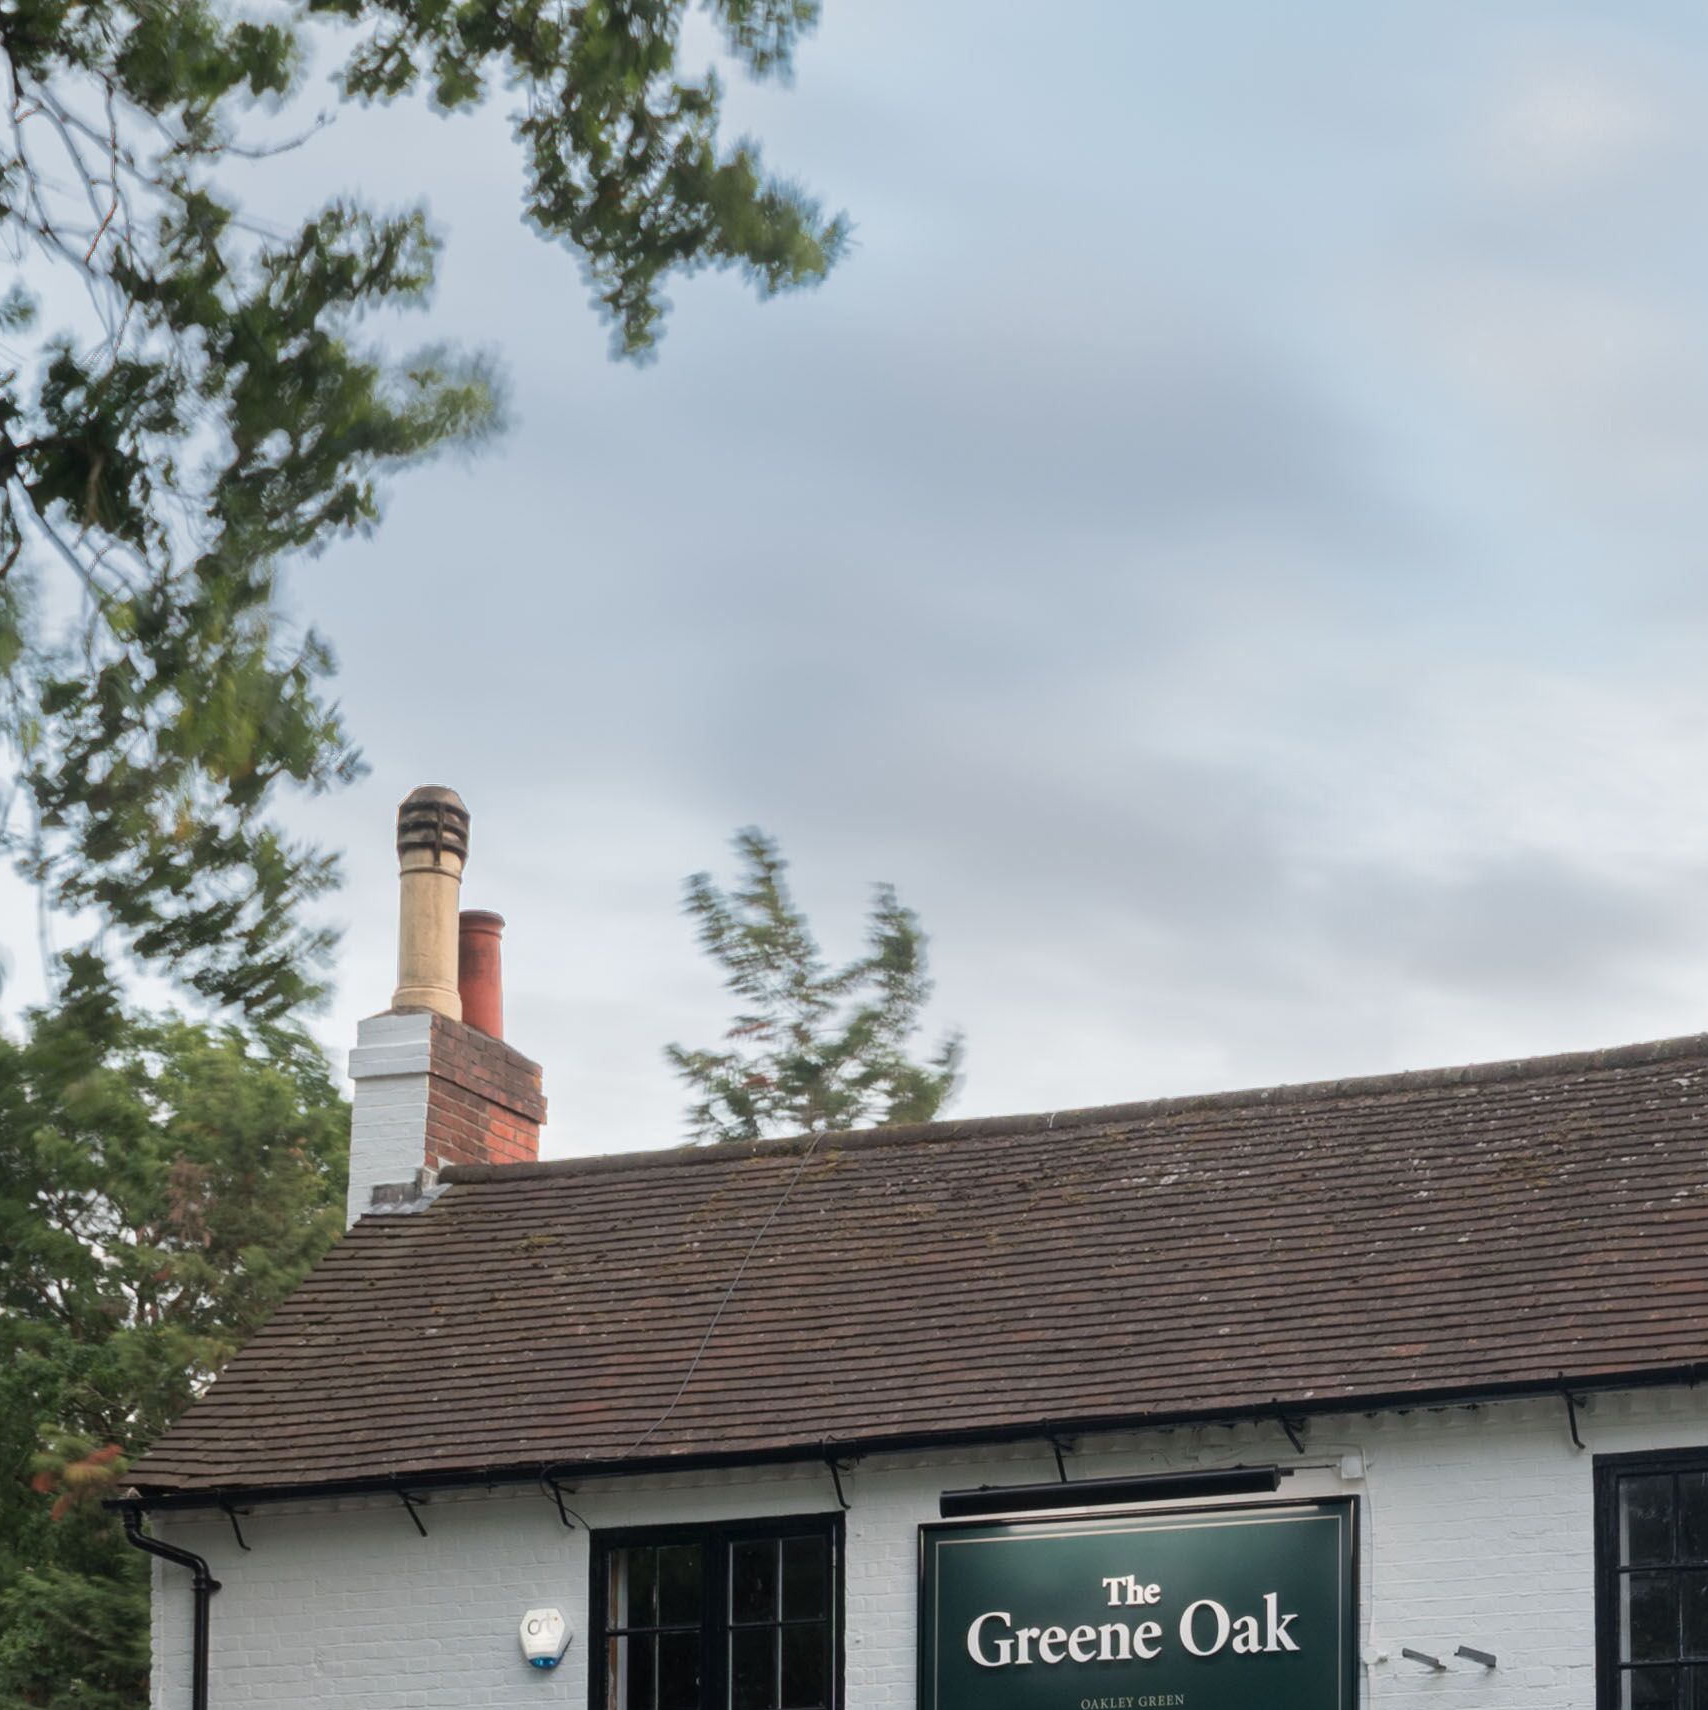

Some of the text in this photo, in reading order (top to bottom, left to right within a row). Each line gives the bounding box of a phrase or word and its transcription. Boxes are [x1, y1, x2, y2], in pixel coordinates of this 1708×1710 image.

[1102, 1574, 1162, 1606] The
[966, 1592, 1301, 1668] Greene Oak
[1080, 1694, 1185, 1710] OAKLEY GREEN
